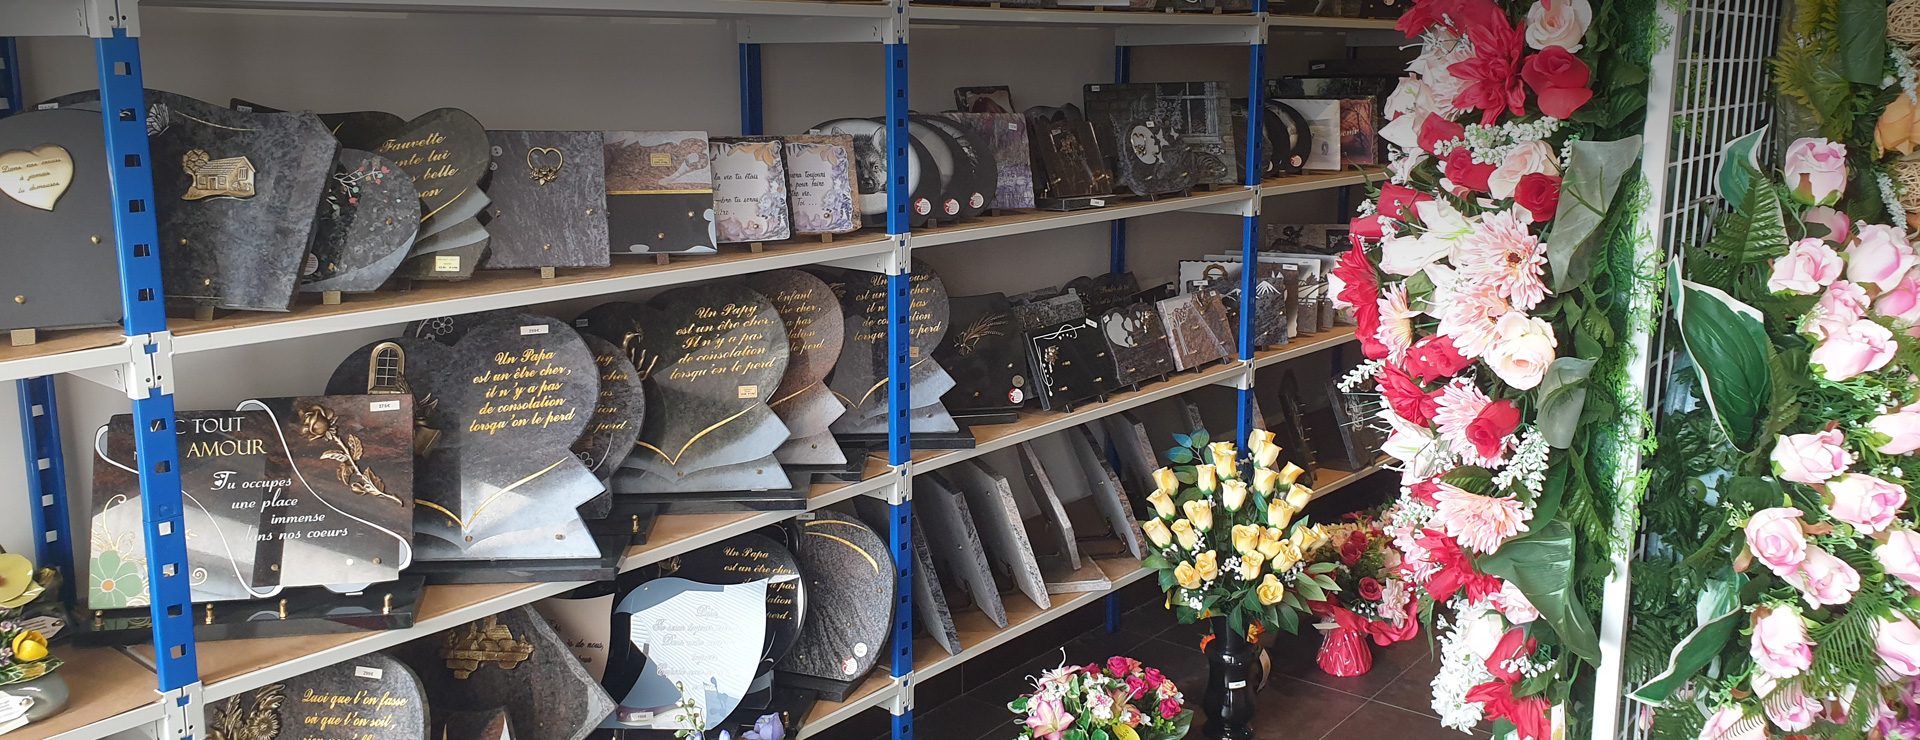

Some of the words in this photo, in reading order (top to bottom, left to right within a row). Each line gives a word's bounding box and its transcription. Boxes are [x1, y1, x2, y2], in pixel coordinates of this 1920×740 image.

[380, 132, 447, 153] Fauvette
[395, 153, 424, 167] nte
[428, 149, 451, 162] lui
[423, 164, 459, 180] belle
[777, 289, 813, 305] Enfant
[855, 290, 870, 301] est
[695, 306, 717, 319] Un
[721, 303, 758, 318] Papy
[781, 304, 793, 314] tre
[866, 302, 877, 313] il
[909, 299, 928, 311] pas
[675, 323, 695, 336] est
[695, 323, 714, 334] un
[717, 319, 740, 331] être
[794, 316, 813, 330] pas
[862, 316, 876, 327] de
[916, 321, 942, 339] perd
[682, 335, 702, 349] Il
[728, 335, 737, 343] a
[737, 332, 763, 346] pas
[790, 342, 799, 352] le
[800, 338, 825, 355] perd
[494, 351, 518, 365] Un
[520, 348, 556, 366] Papa
[678, 353, 694, 364] de
[696, 344, 767, 361] consolation
[731, 358, 742, 372] le
[742, 356, 777, 375] perd
[473, 370, 491, 384] est
[493, 371, 512, 382] un
[514, 366, 537, 380] être
[485, 386, 497, 399] il
[527, 385, 538, 394] a
[537, 380, 564, 398] pas
[479, 402, 496, 415] de
[497, 395, 567, 413] consolation
[192, 416, 246, 434] TOUT
[531, 412, 544, 425] le
[543, 407, 576, 429] perd
[186, 438, 268, 459] AMOUR
[210, 470, 237, 491] Tu
[241, 477, 292, 492] occupes
[231, 500, 256, 510] une
[260, 487, 298, 513] place
[270, 513, 326, 525] immense
[278, 531, 301, 541] nos
[307, 527, 349, 539] coeurs
[723, 546, 740, 556] Un
[741, 547, 769, 561] Papa
[724, 563, 739, 571] est
[754, 564, 770, 572] être
[776, 582, 796, 592] pas
[302, 688, 329, 703] Quoi
[330, 694, 352, 709] que
[353, 690, 379, 705] l'on
[376, 691, 408, 711] fasse
[320, 715, 342, 731] que
[343, 711, 370, 727] l'on
